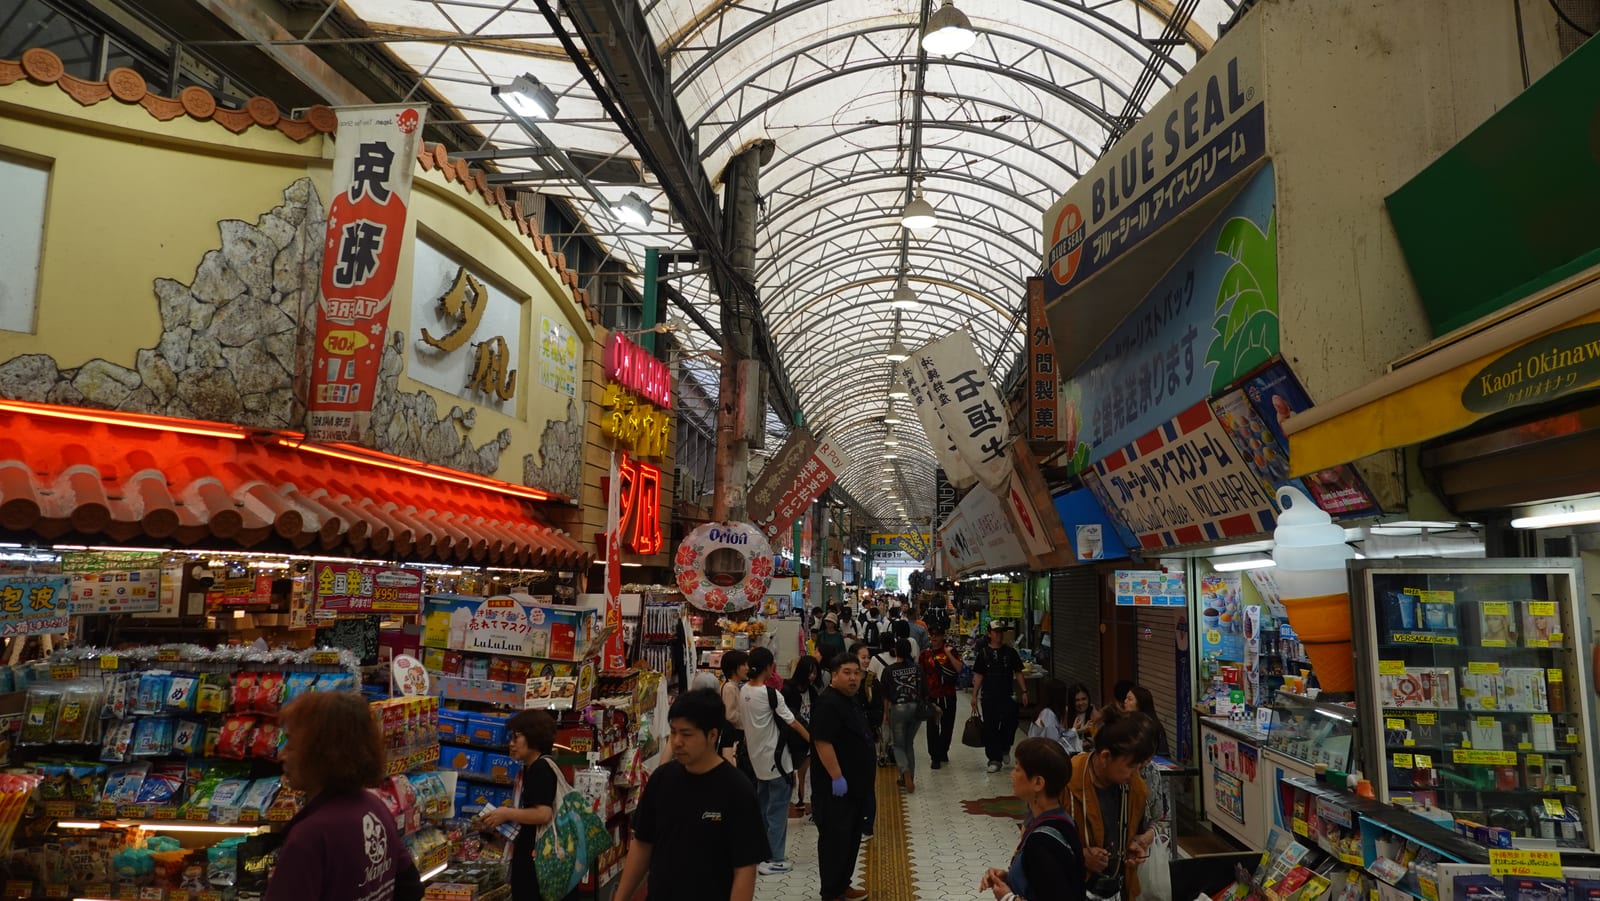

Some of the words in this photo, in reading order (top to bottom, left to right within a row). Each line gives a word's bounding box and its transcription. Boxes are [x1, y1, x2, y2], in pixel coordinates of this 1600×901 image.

[1092, 131, 1154, 225] BLUE
[1164, 56, 1245, 167] SEAL
[1092, 205, 1149, 265] ブルーシール
[1153, 128, 1246, 221] アイスクリーム
[1051, 241, 1068, 263] BLUE
[1068, 229, 1084, 250] SEAL
[1033, 326, 1054, 441] 外間製菓
[1481, 362, 1523, 398] Kaori
[1508, 372, 1578, 405] カオリオキナワ
[828, 450, 843, 469] Pay
[1110, 463, 1160, 505] ブルーシール
[1150, 431, 1233, 490] アイスクリーム
[781, 470, 829, 518] お支払いは
[1186, 470, 1266, 519] MIZUHARA
[708, 527, 748, 545] Orion
[319, 565, 373, 598] 全国発送
[374, 587, 398, 601] ¥950
[473, 637, 523, 652] LuLuLun
